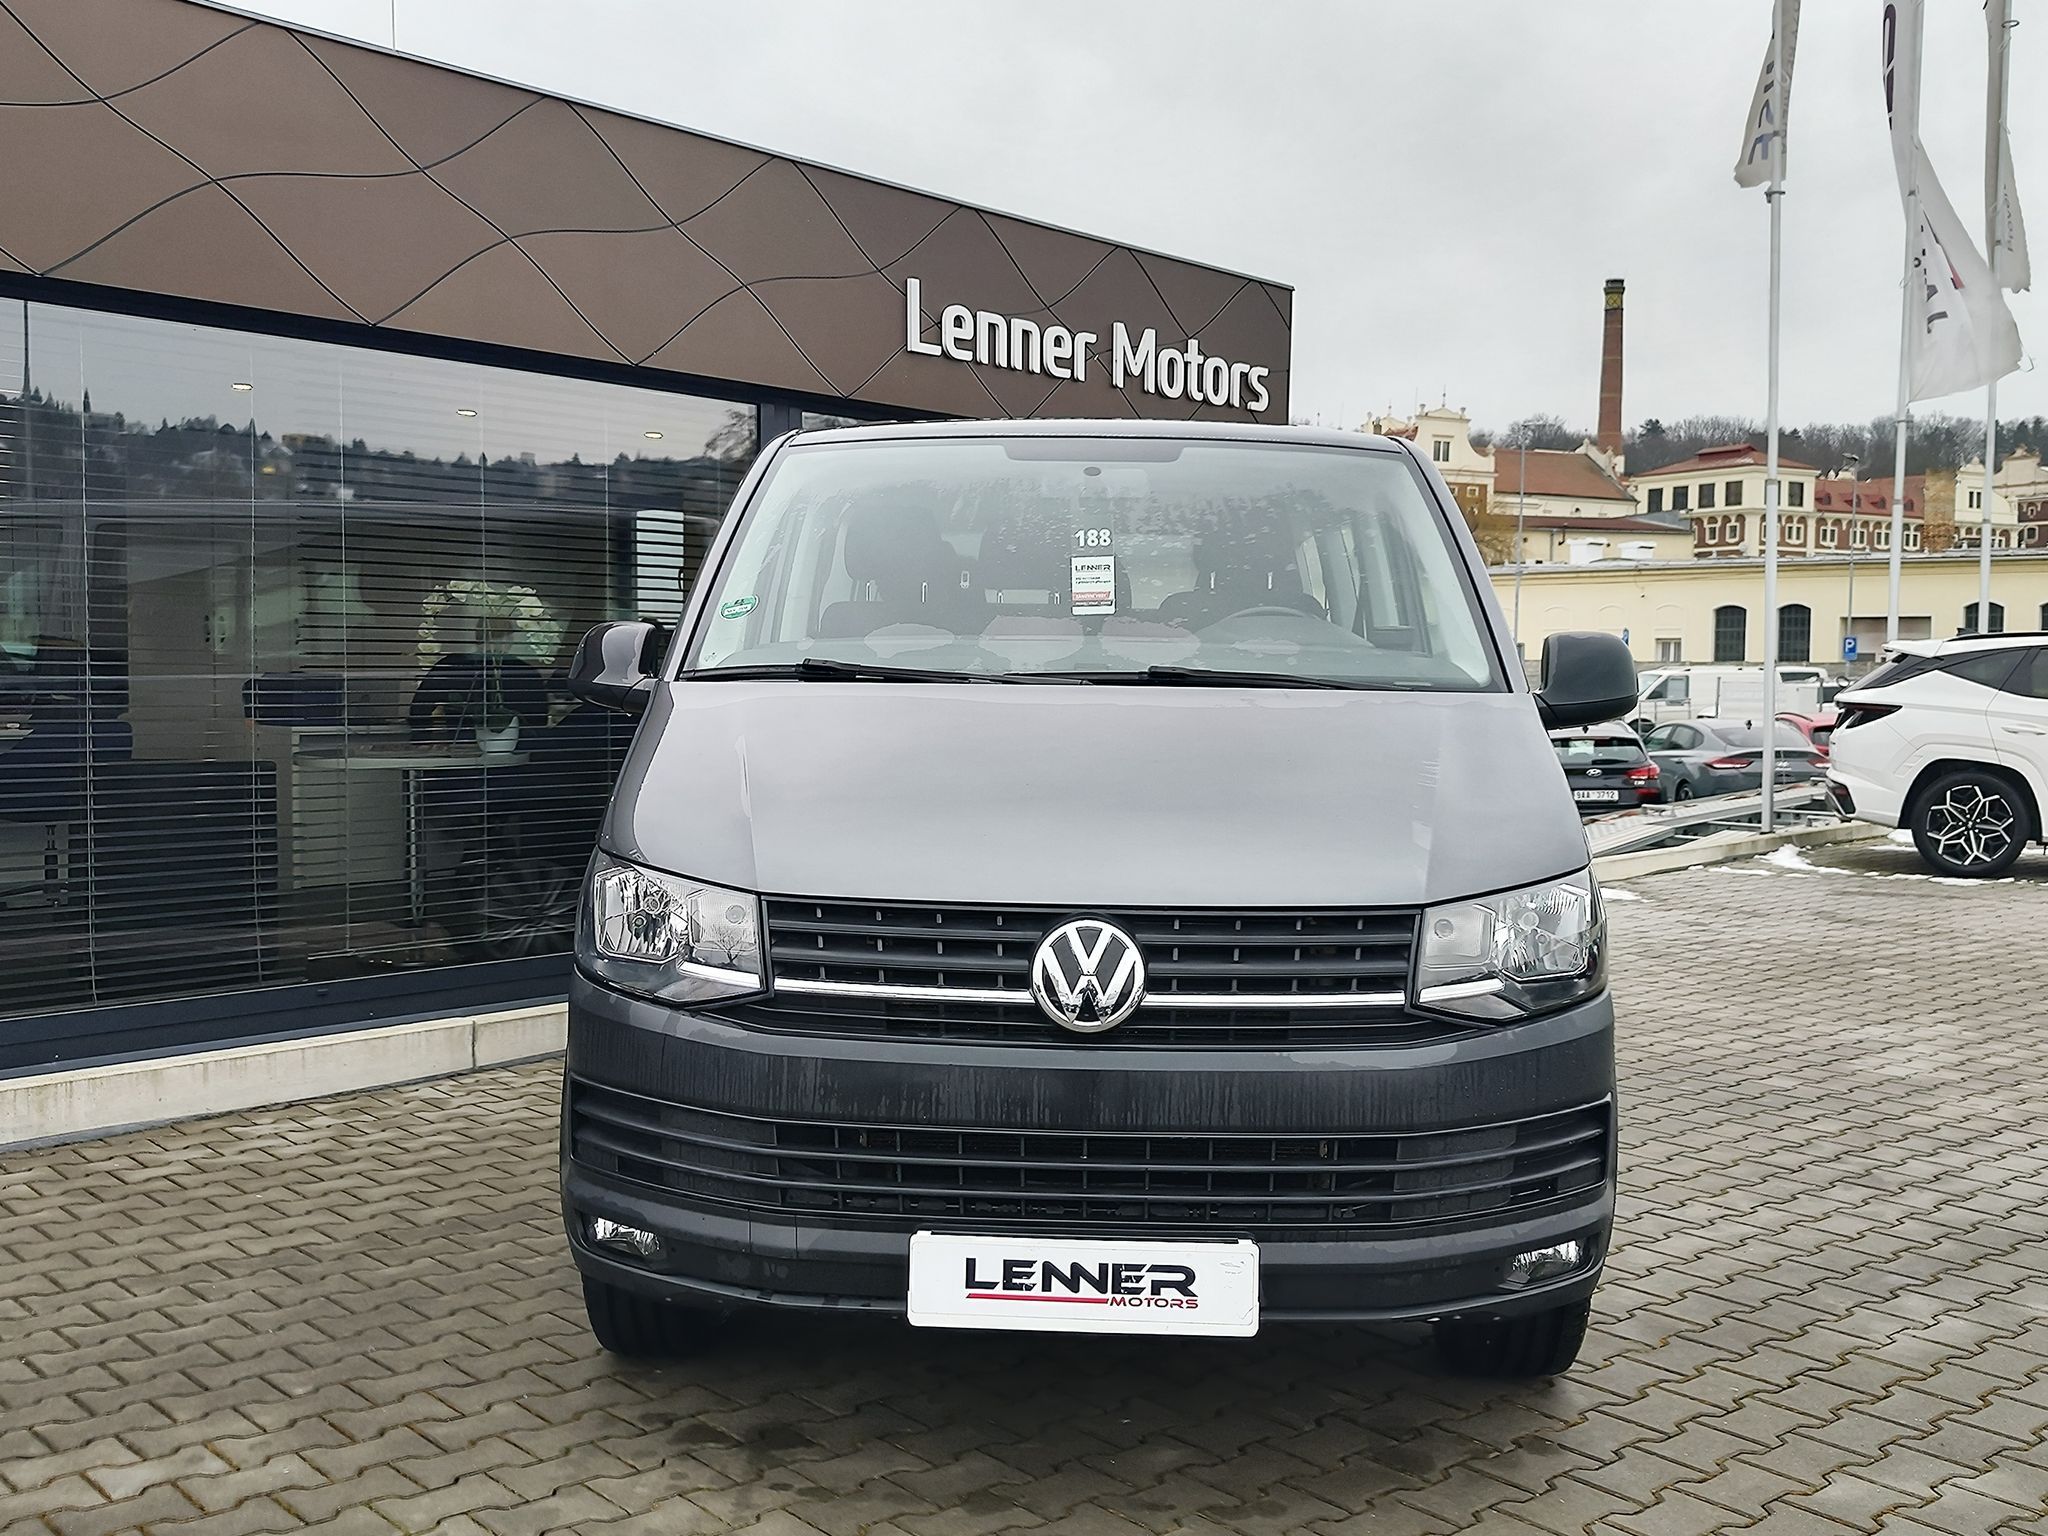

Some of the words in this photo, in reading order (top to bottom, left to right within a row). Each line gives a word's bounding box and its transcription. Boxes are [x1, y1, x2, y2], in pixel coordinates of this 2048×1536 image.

[906, 276, 1098, 383] Lenner
[1111, 320, 1270, 413] Motors
[1074, 528, 1112, 548] 188
[1845, 638, 1855, 652] P
[965, 1257, 1199, 1298] LENNER
[1109, 1296, 1199, 1309] MOTORS
